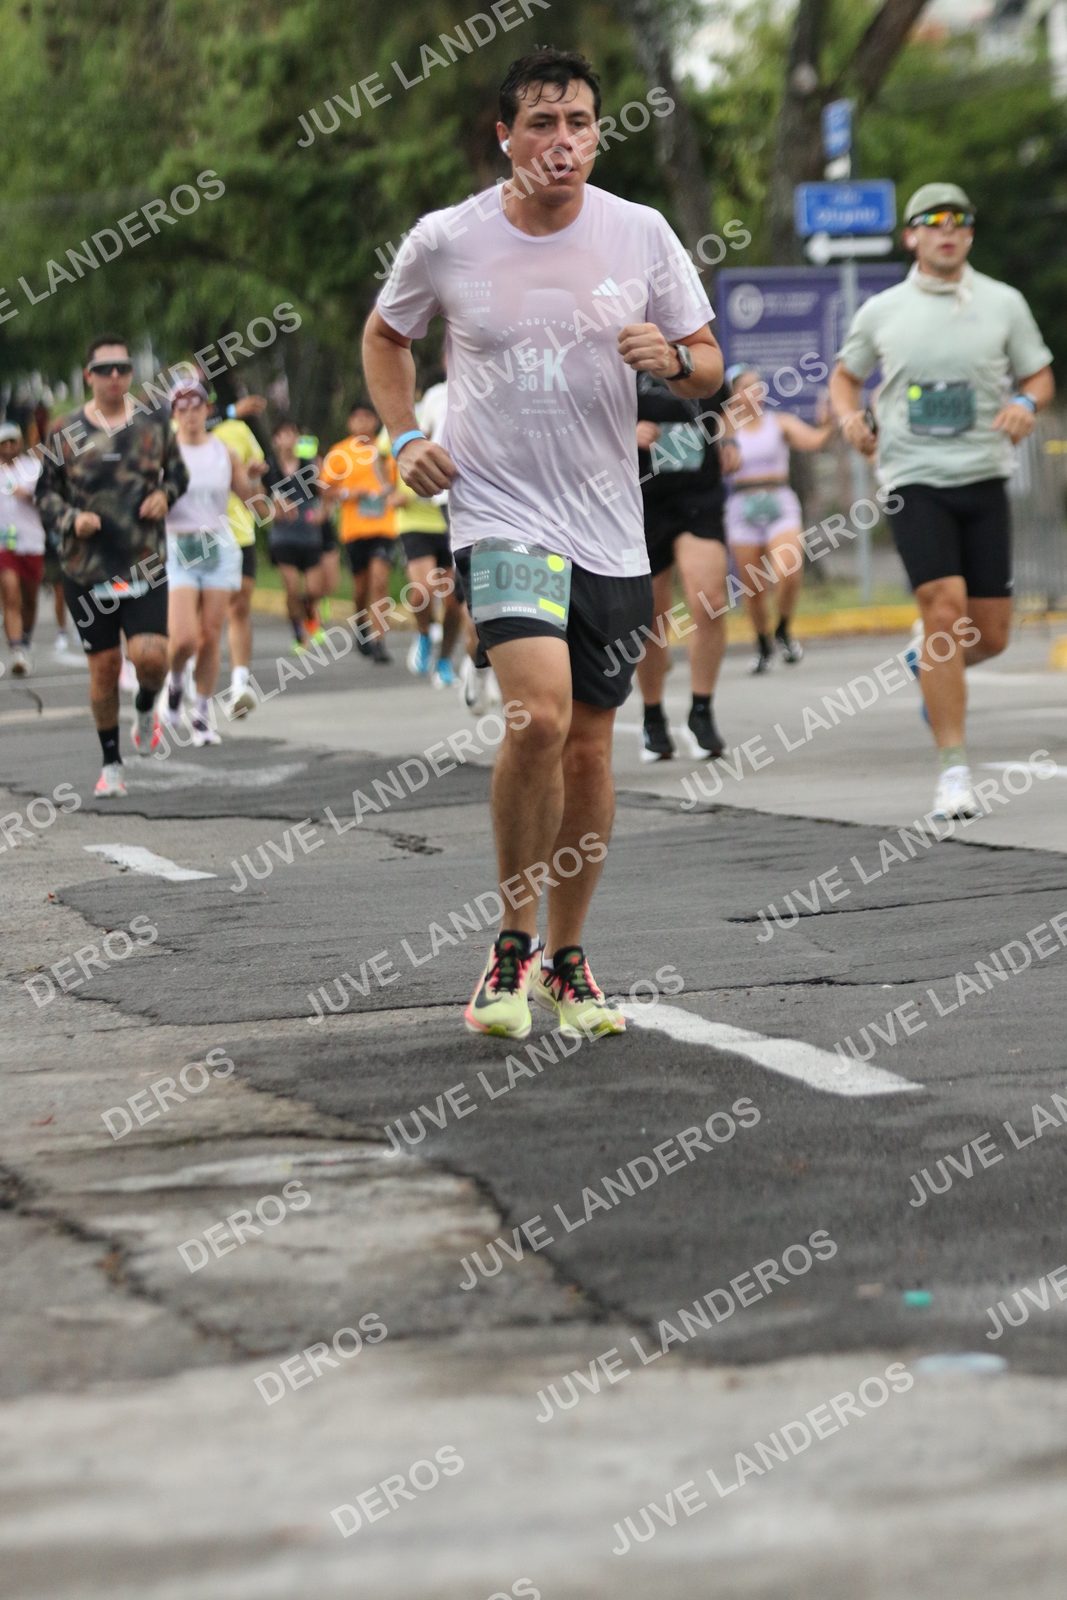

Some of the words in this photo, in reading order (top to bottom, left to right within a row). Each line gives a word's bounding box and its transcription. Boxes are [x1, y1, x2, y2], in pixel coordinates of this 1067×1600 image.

[517, 374, 538, 391] 30
[543, 348, 569, 392] K
[495, 561, 566, 601] 0923
[502, 606, 537, 614] SAMSUNG
